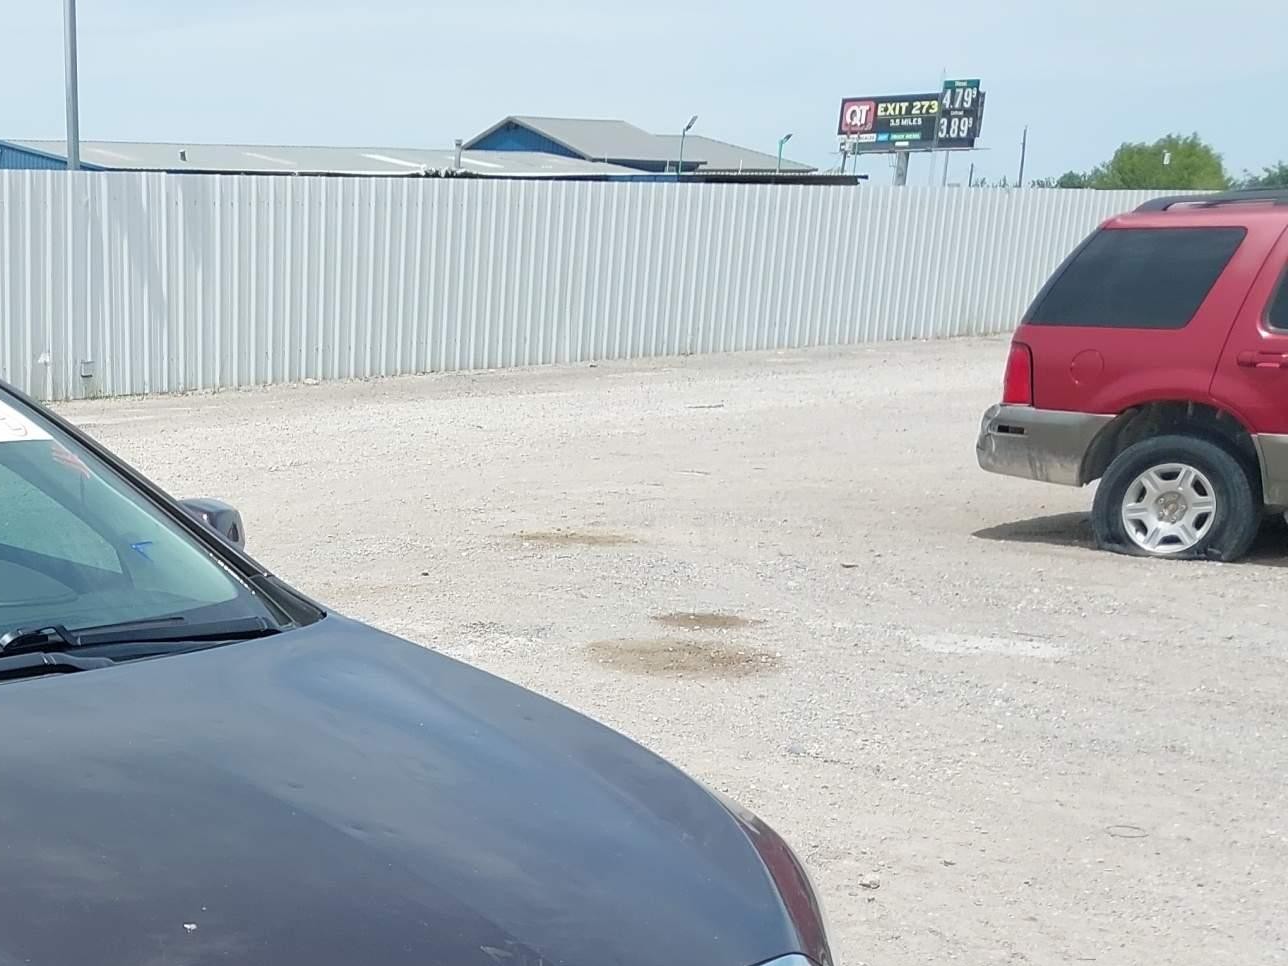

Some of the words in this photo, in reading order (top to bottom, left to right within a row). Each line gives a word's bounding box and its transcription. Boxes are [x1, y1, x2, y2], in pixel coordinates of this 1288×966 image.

[846, 105, 870, 126] QT
[877, 102, 910, 116] EXIT
[911, 100, 939, 115] 273
[901, 117, 923, 126] MILES
